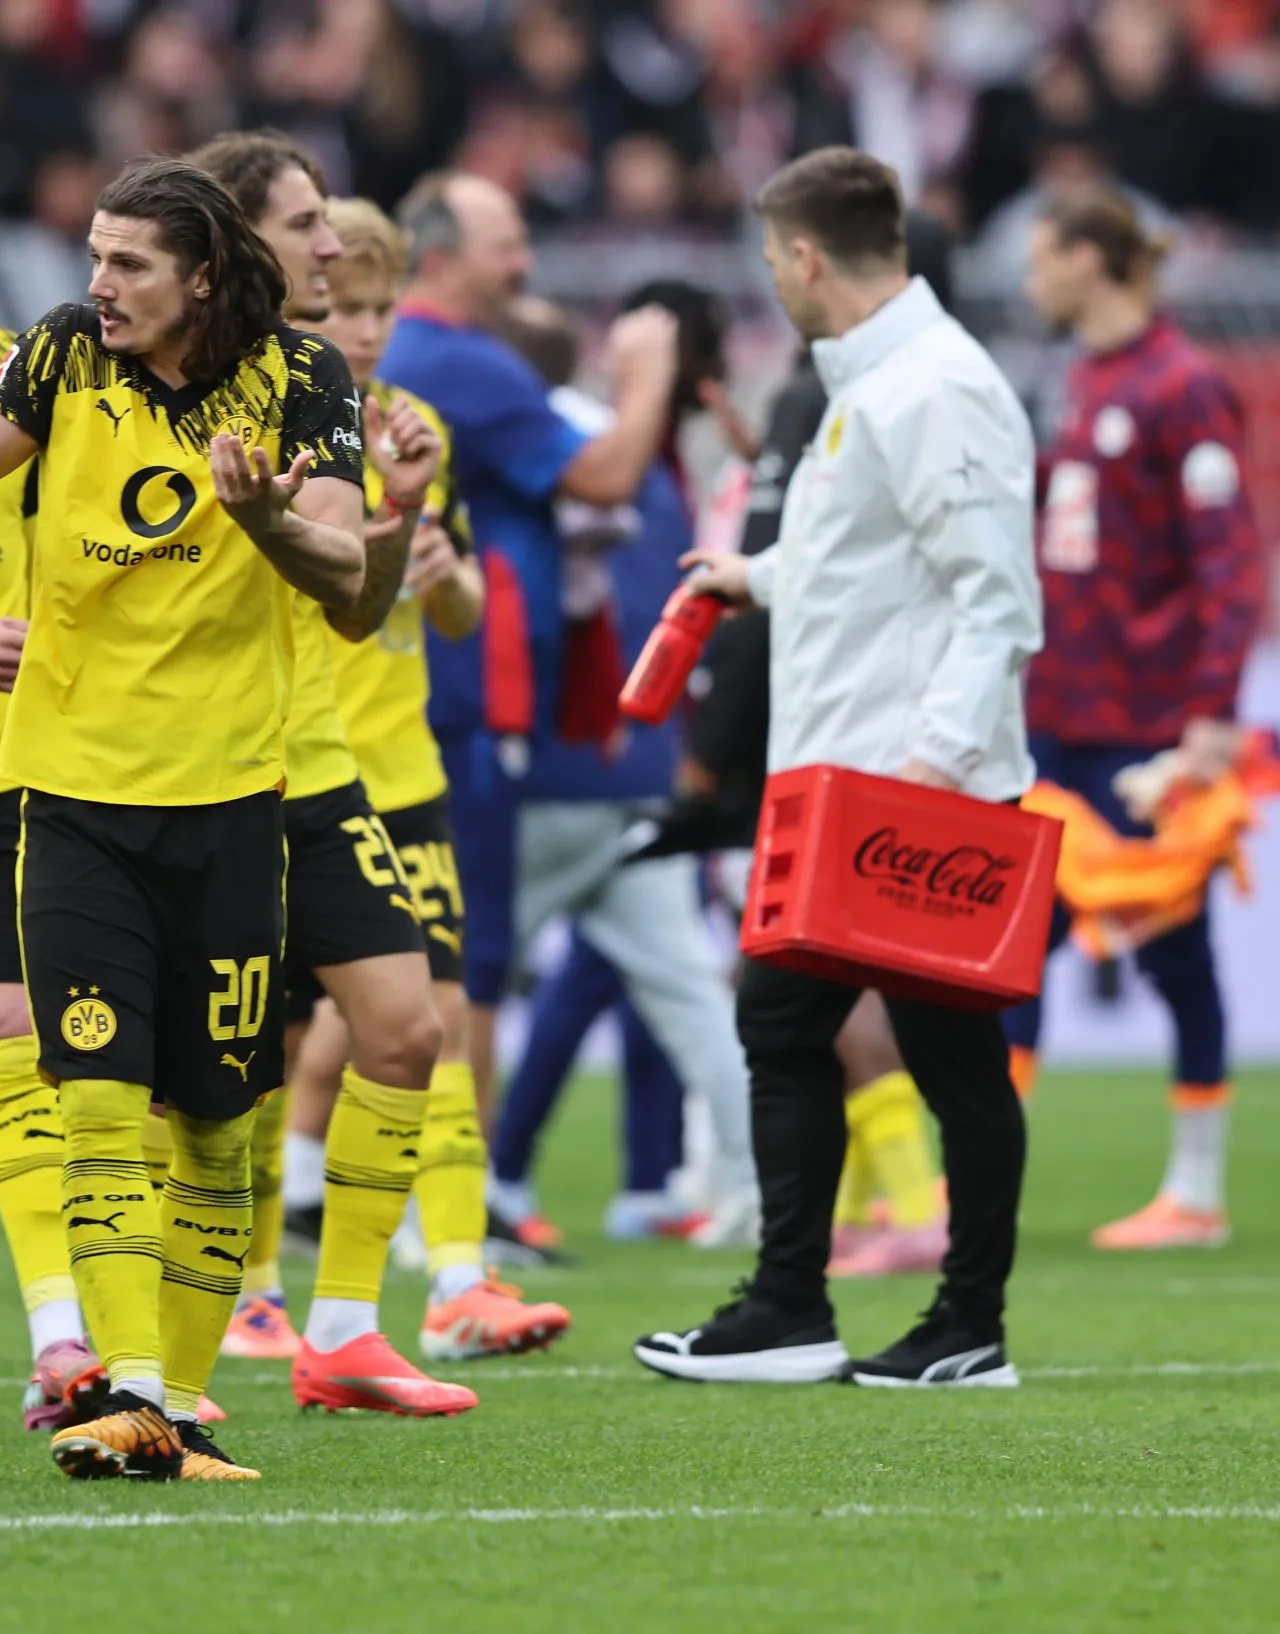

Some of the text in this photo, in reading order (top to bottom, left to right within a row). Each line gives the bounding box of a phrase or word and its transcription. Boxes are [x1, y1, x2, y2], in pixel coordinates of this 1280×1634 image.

[332, 426, 363, 450] Pole
[81, 538, 202, 567] vodaone
[208, 955, 270, 1041] 20
[70, 1005, 109, 1037] BVB
[173, 1217, 238, 1237] BVB
